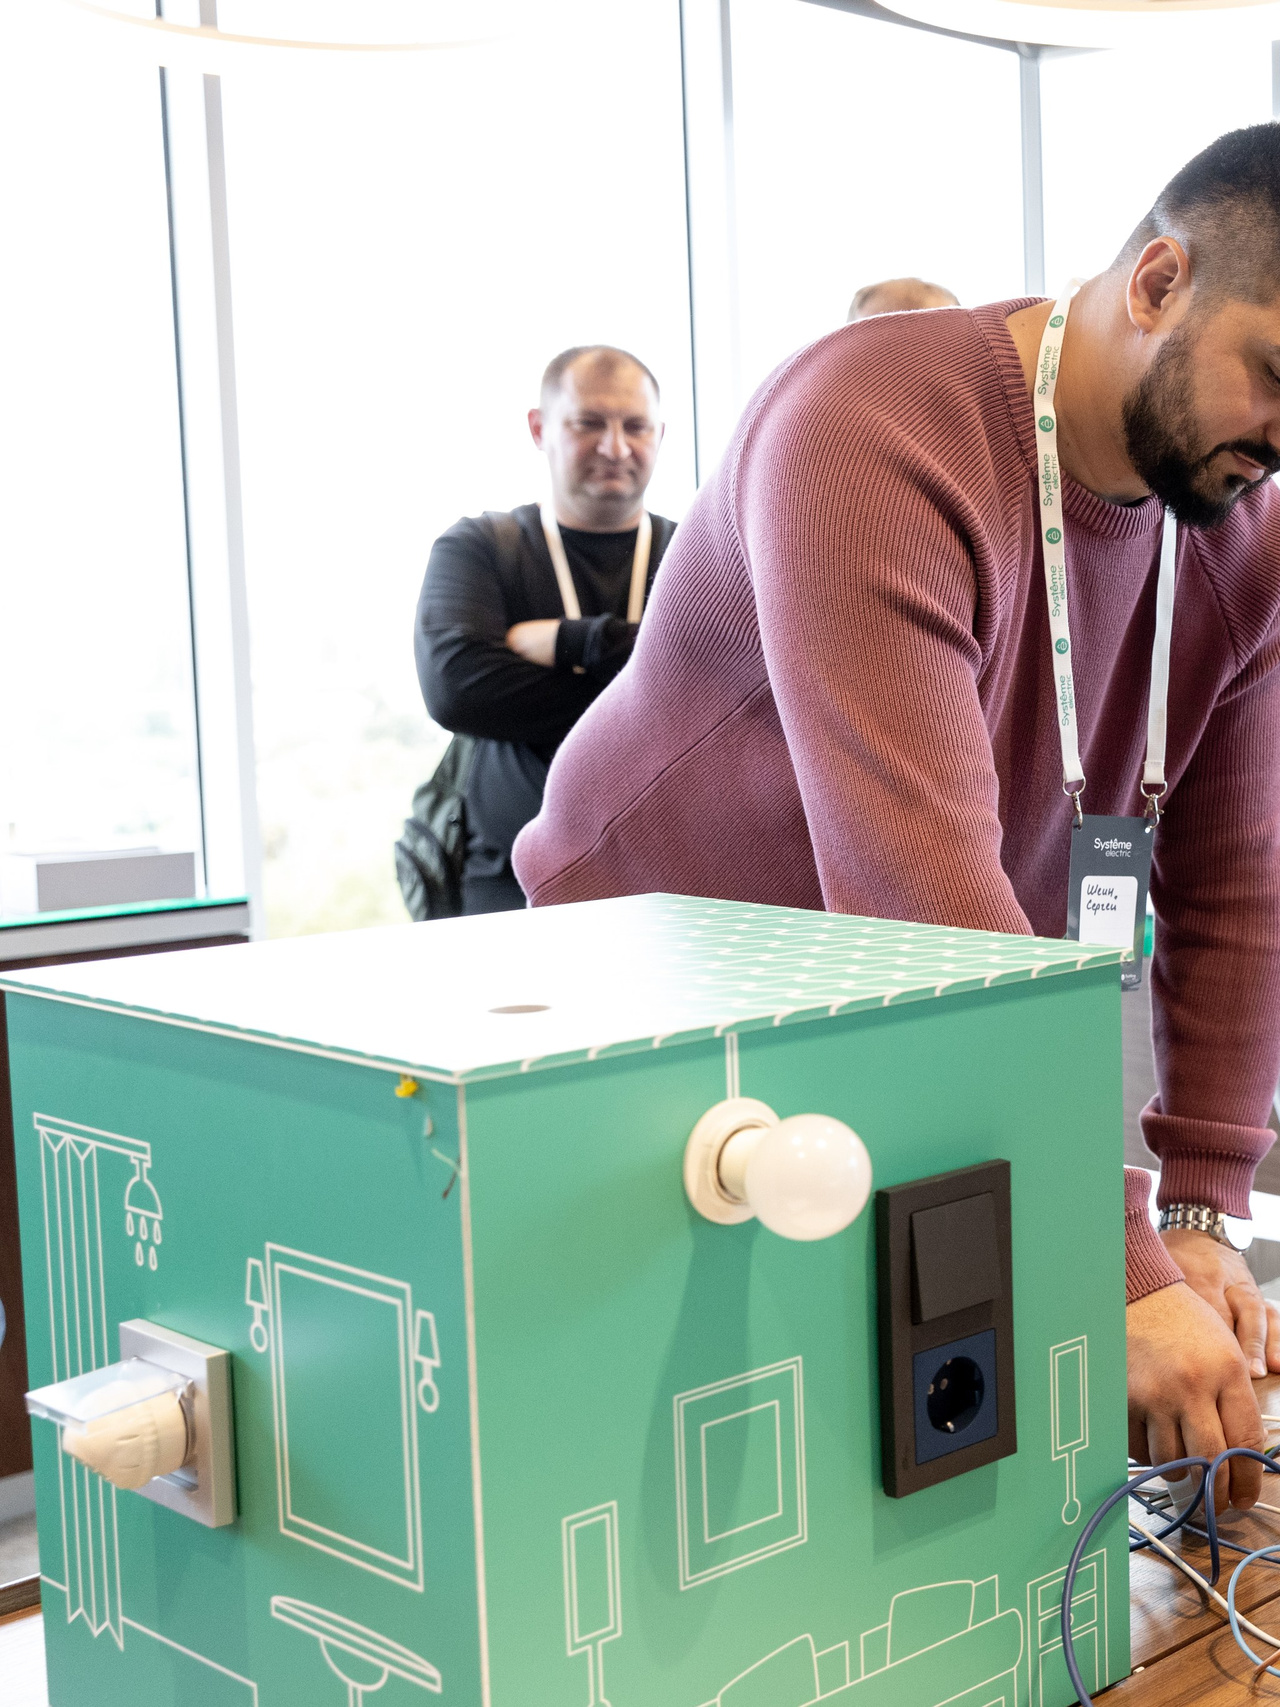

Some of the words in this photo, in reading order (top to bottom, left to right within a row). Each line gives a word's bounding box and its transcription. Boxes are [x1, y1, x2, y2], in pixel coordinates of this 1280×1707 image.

[1042, 453, 1053, 507] Systême
[1050, 565, 1061, 617] Systême
[1093, 837, 1132, 851] Systême
[1105, 849, 1132, 857] electric
